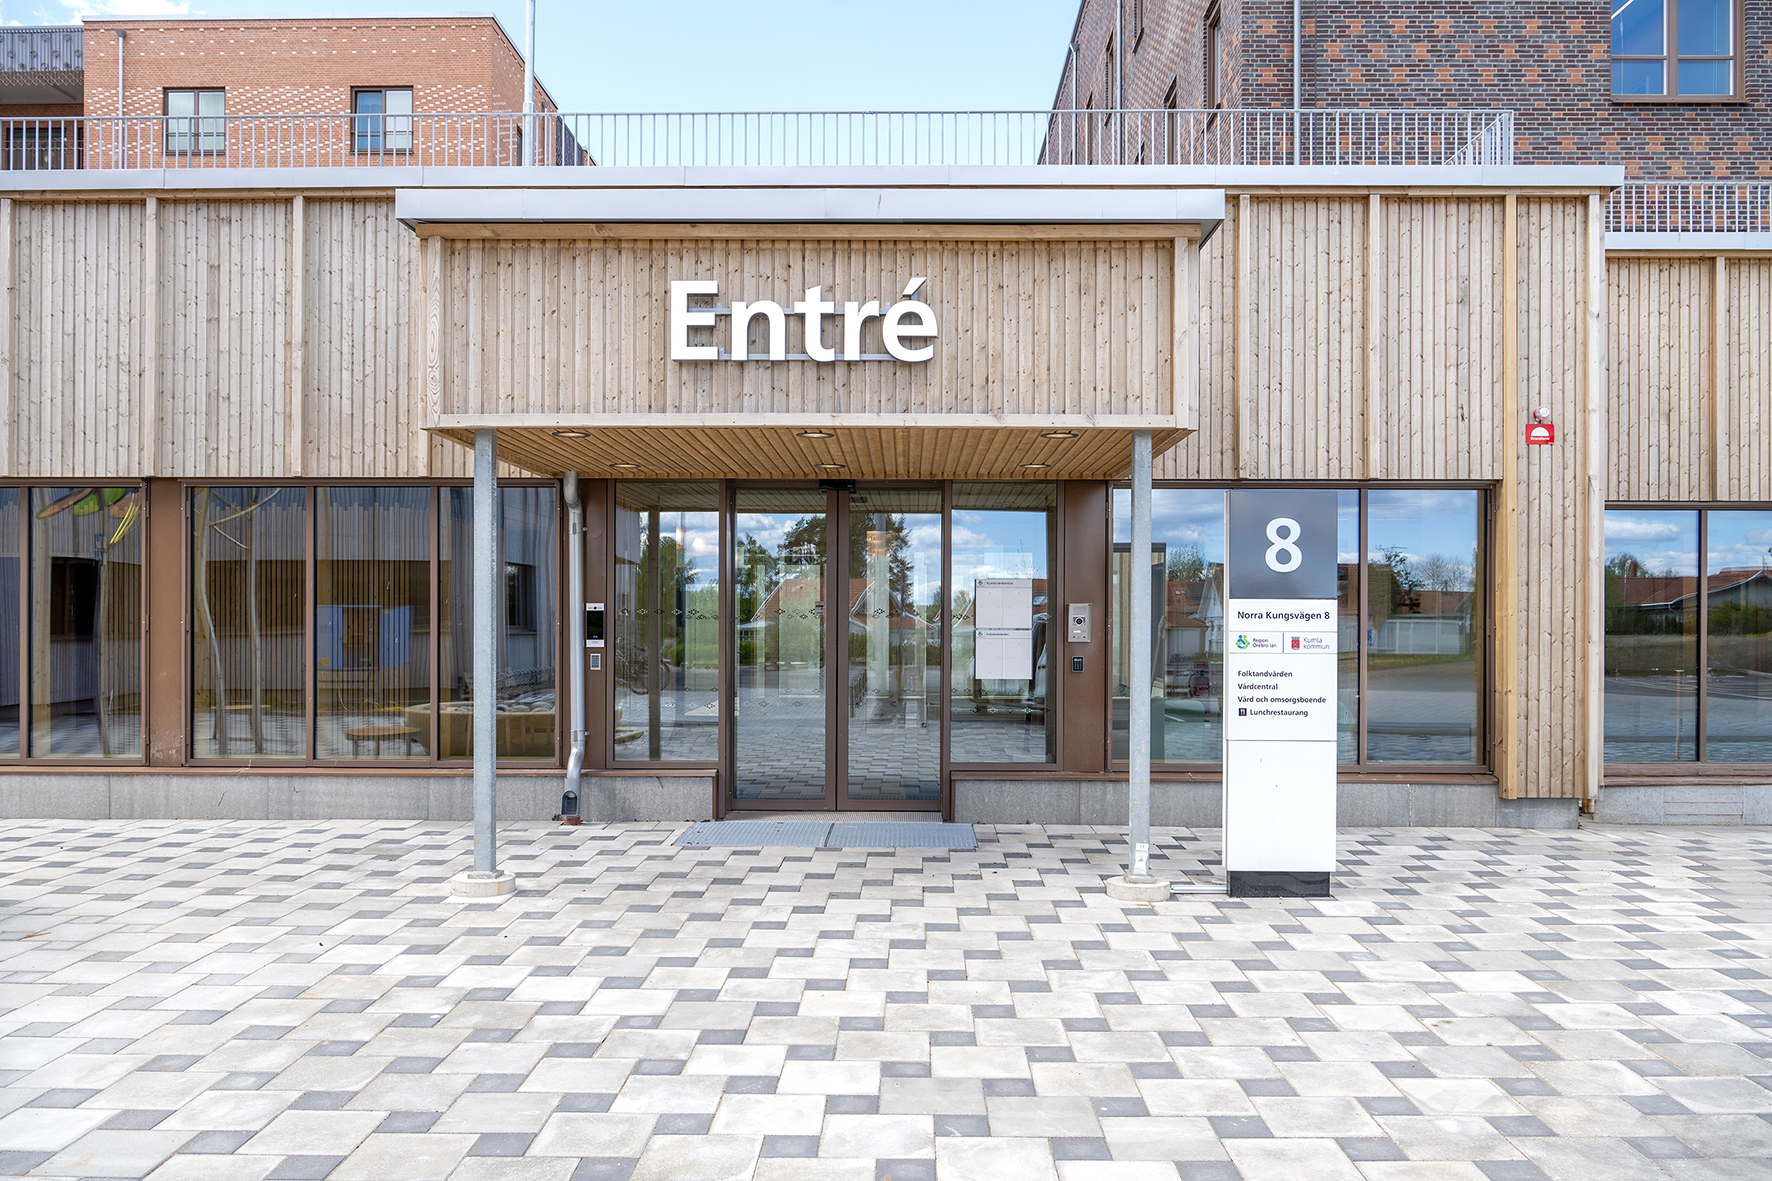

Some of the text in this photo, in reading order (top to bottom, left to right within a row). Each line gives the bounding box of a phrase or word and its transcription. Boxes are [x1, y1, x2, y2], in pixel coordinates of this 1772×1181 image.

[670, 277, 939, 363] Entré
[1265, 517, 1303, 573] 8
[1237, 611, 1331, 622] Norra Kungsvägen 8
[1237, 670, 1293, 678] Folktandvården
[1237, 695, 1254, 703] Vård
[1270, 696, 1327, 705] omsorgsboende
[1249, 708, 1309, 718] Lunchrestaurang
